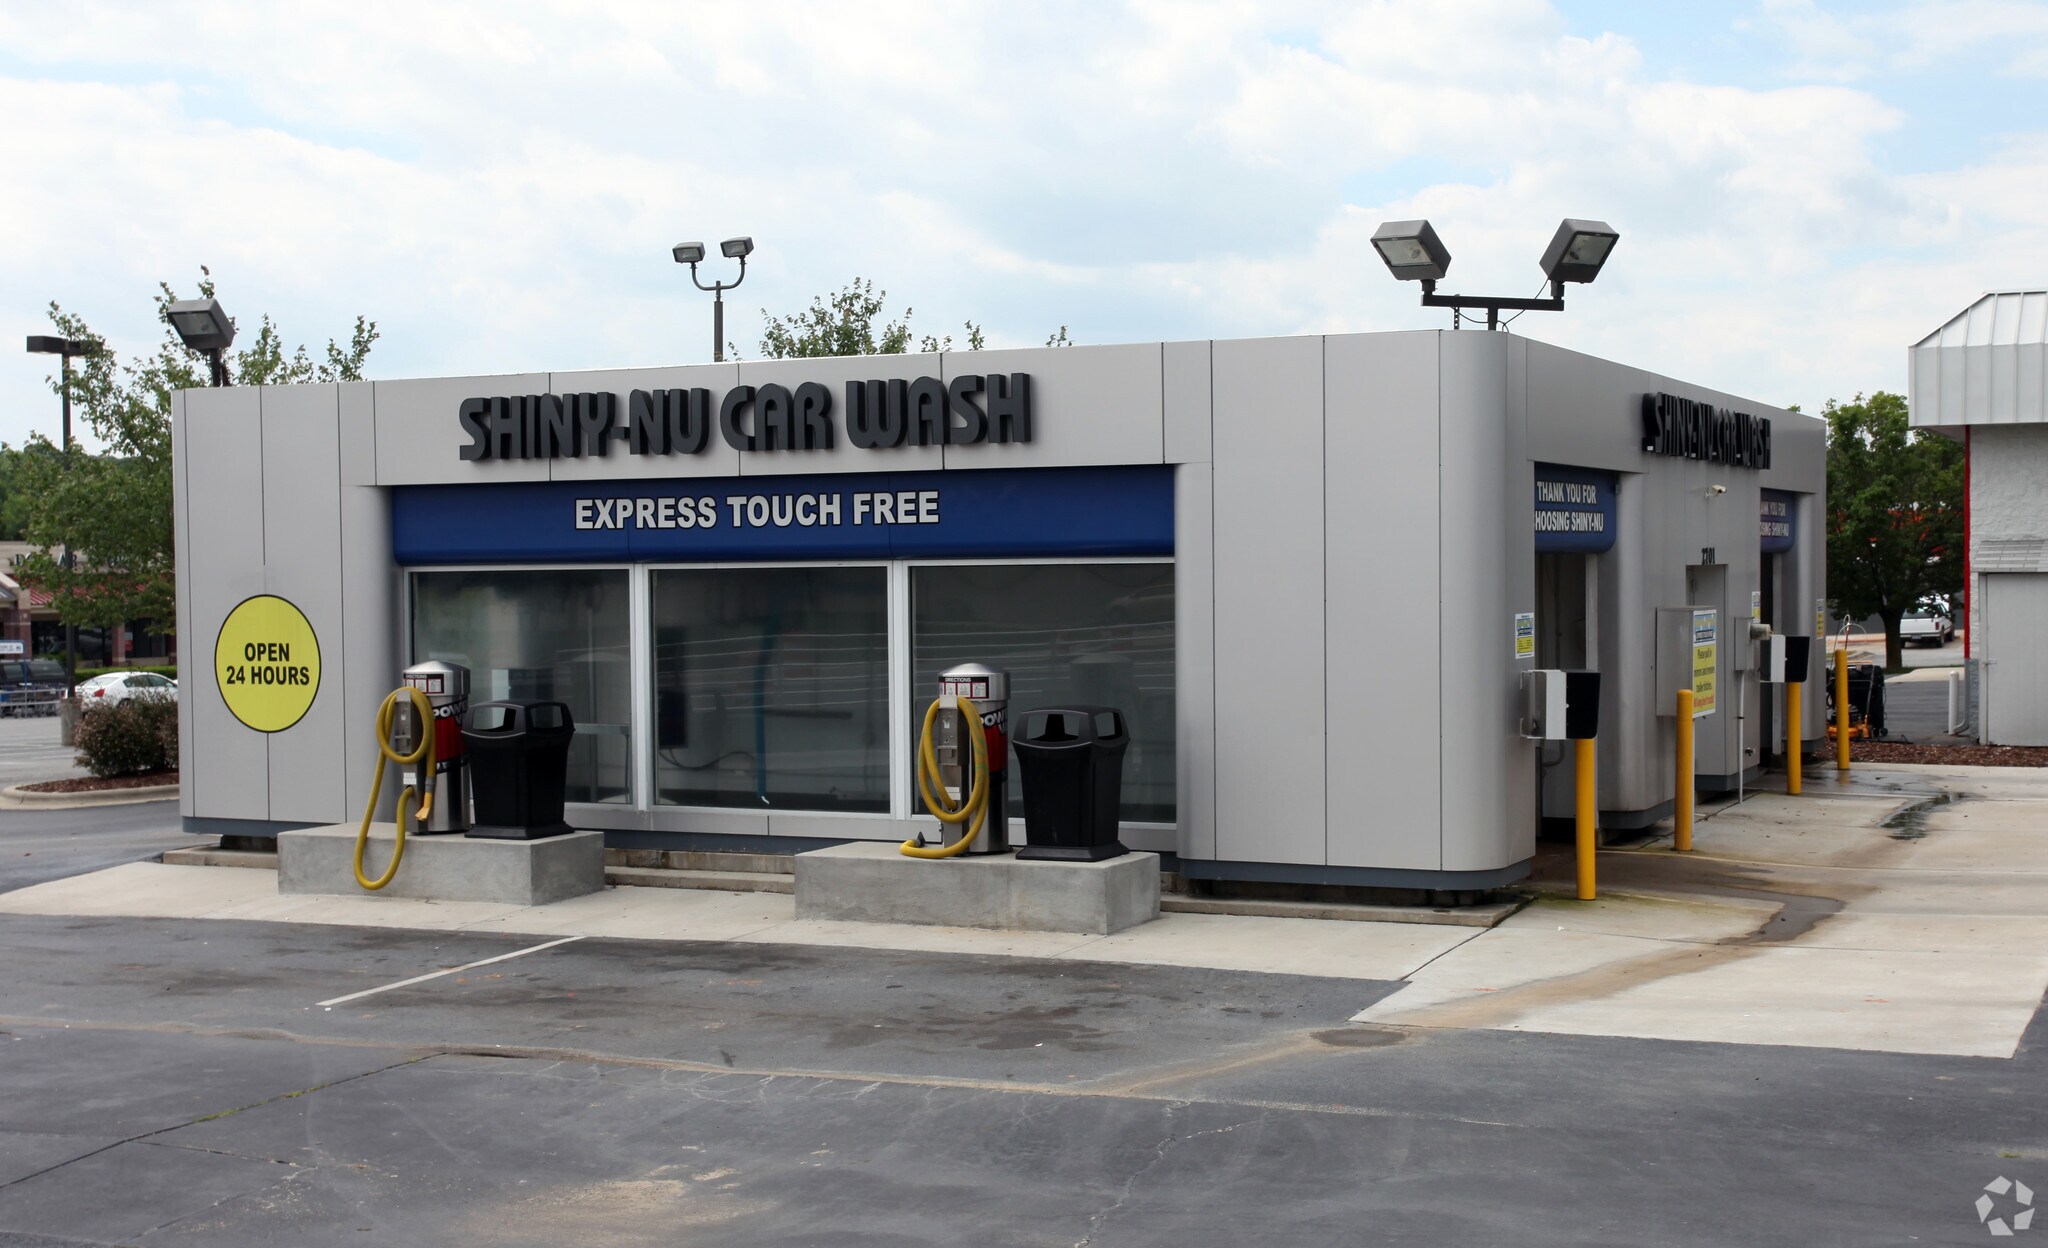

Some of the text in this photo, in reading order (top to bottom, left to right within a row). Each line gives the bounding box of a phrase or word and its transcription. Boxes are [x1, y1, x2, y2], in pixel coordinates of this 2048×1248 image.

[459, 372, 1032, 460] SHINY-NU CAR WASH
[1645, 391, 1771, 470] SHINY-NU CAR WASH
[1536, 480, 1597, 504] THANK YOU FOR
[575, 490, 940, 530] EXPRESS TOUCH FREE
[1534, 510, 1604, 532] HOOSING SHINY-NU
[244, 642, 290, 662] OPEN
[226, 665, 310, 686] 24 HOURS
